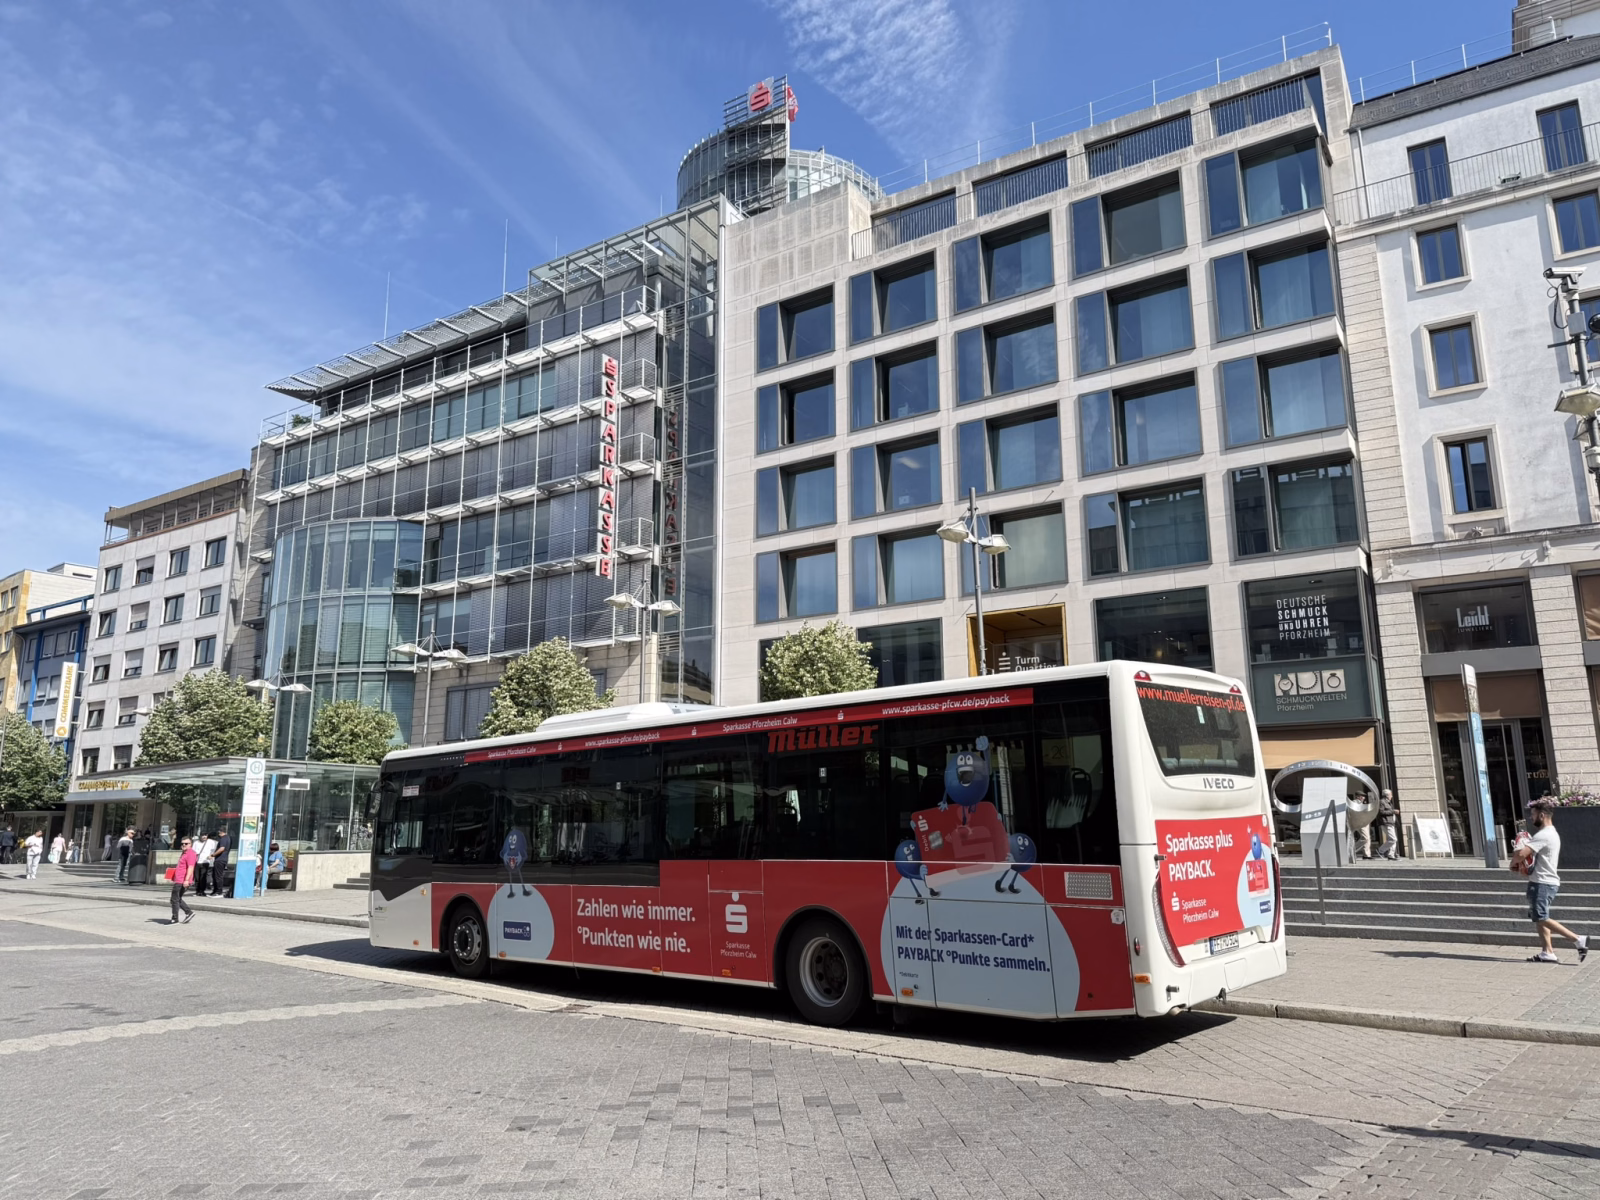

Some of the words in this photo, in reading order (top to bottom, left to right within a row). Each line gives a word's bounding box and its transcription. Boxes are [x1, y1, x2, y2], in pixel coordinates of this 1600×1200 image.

[600, 378, 617, 578] SPARKASSE
[1276, 594, 1327, 609] DEUTSCHE
[1278, 606, 1328, 621] SCHMUCK
[1279, 622, 1294, 631] UND
[1295, 617, 1329, 630] UHREN
[1279, 628, 1331, 640] PFORZHEIM
[1015, 656, 1040, 665] Turm
[60, 665, 73, 722] COMMERZBANK
[1276, 692, 1347, 705] SCHMUCKWELTEN
[882, 693, 1010, 715] www.sparkasse-pfcw.de/payback
[1277, 703, 1314, 711] Pforzheim
[723, 720, 752, 733] Sparkasse
[752, 718, 783, 730] Pforzheim
[783, 716, 798, 726] Calw
[1202, 777, 1235, 789] IVECO
[1166, 832, 1214, 856] Sparkasse
[1216, 829, 1234, 853] plus
[1168, 859, 1216, 882] PAYBACK.
[577, 898, 618, 918] Zahlen
[621, 899, 645, 919] wie
[648, 899, 696, 922] immer.
[1181, 898, 1207, 911] Sparkasse
[1182, 912, 1209, 925] Pforzheim
[1209, 908, 1220, 920] Calw
[896, 925, 912, 939] Mit
[915, 927, 932, 941] der
[637, 930, 662, 951] wie
[665, 931, 691, 953] nie.
[725, 940, 751, 950] Sparkasse
[897, 946, 945, 963] PAYBACK
[993, 956, 1050, 972] sammeln.
